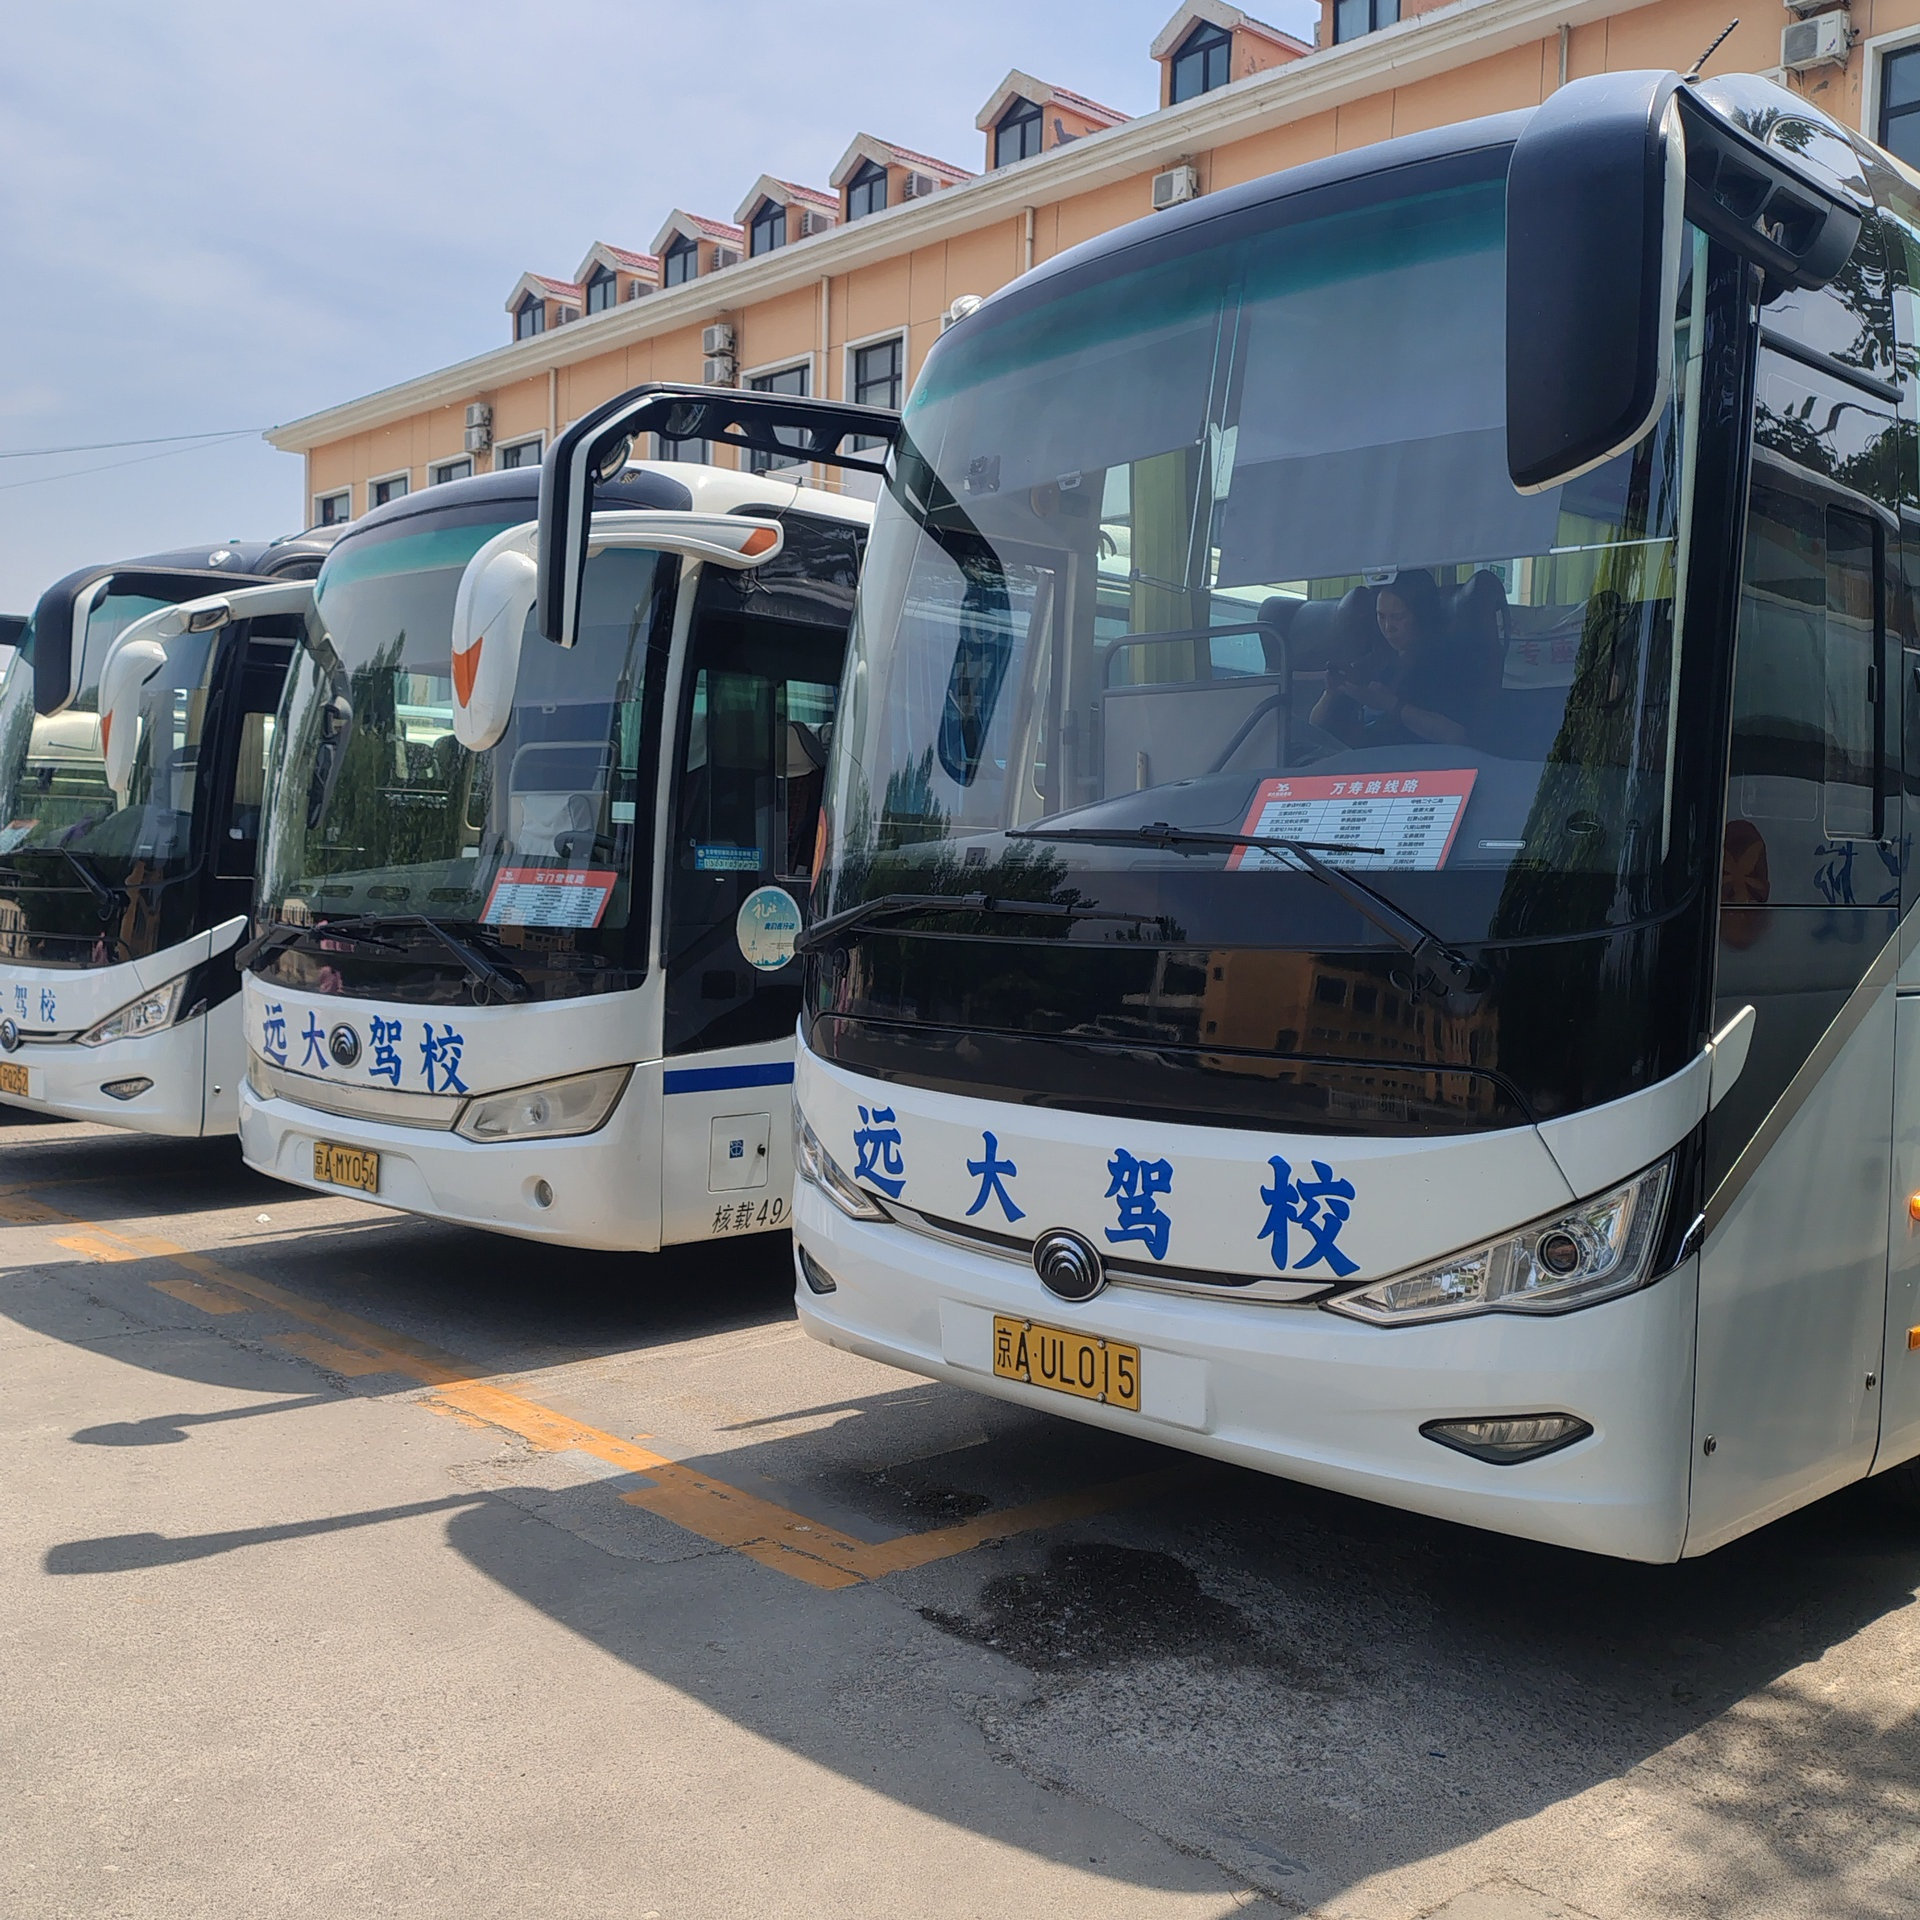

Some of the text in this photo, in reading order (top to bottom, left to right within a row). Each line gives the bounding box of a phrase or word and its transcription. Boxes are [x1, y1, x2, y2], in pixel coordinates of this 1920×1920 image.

[1330, 778, 1419, 796] 万寿路线路
[0, 984, 56, 1023] 驾校
[263, 1003, 469, 1094] 远大驾校
[854, 1105, 1360, 1277] 远大驾校
